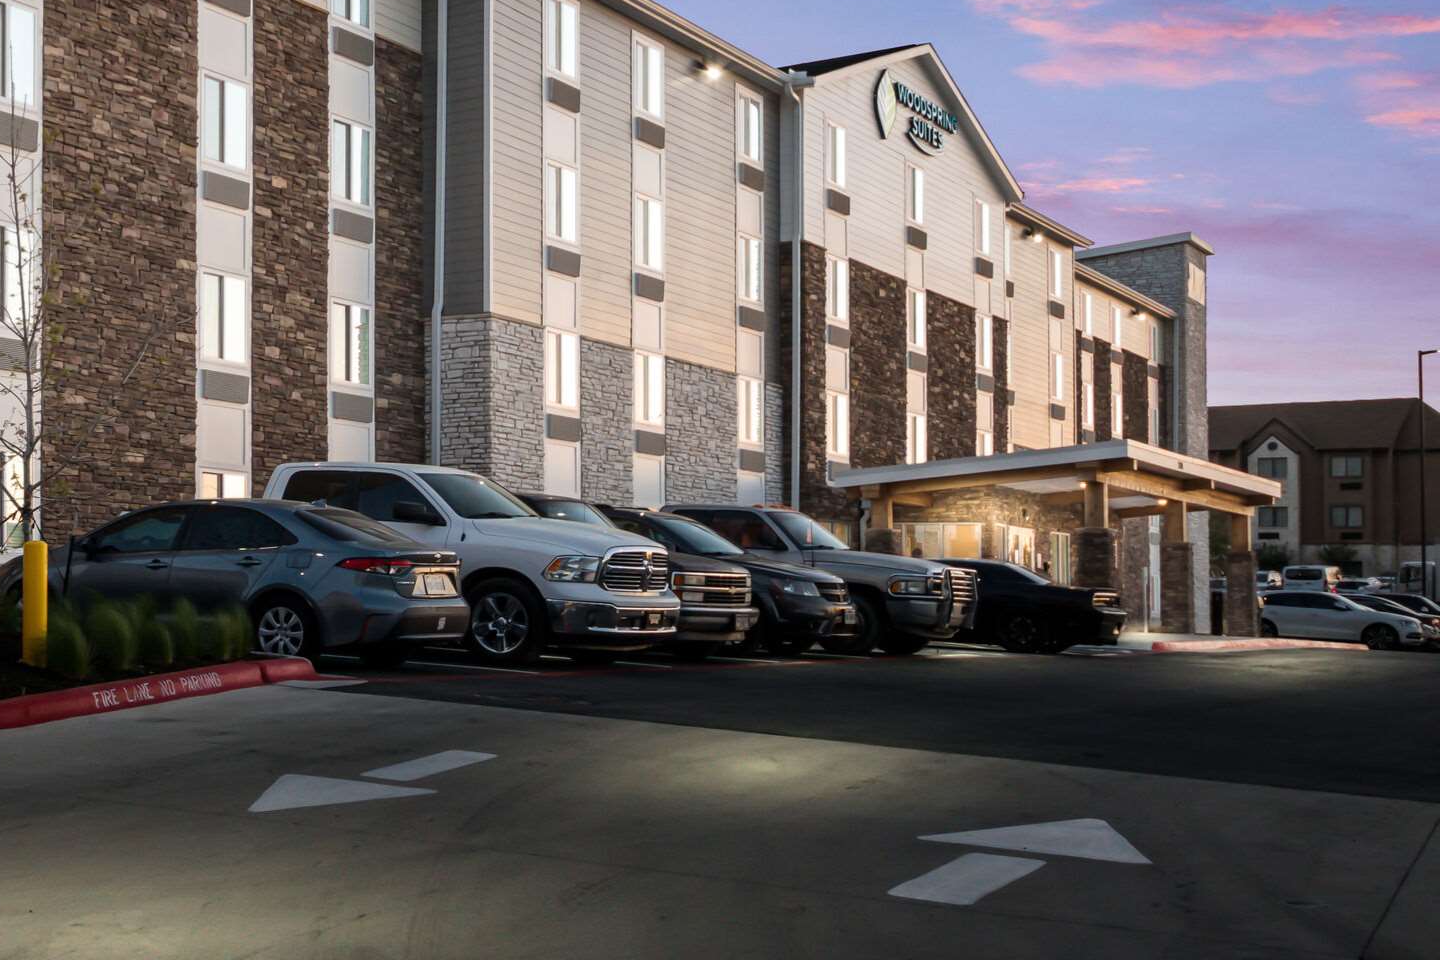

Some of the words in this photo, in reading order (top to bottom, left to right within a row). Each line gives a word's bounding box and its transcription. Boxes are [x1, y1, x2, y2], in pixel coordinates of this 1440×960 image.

[896, 82, 959, 135] WOODSPRING
[911, 116, 944, 149] SUITES
[92, 688, 120, 708] FIRE
[124, 682, 154, 702] LANE
[160, 679, 176, 696] NO
[180, 672, 222, 693] PARKING
